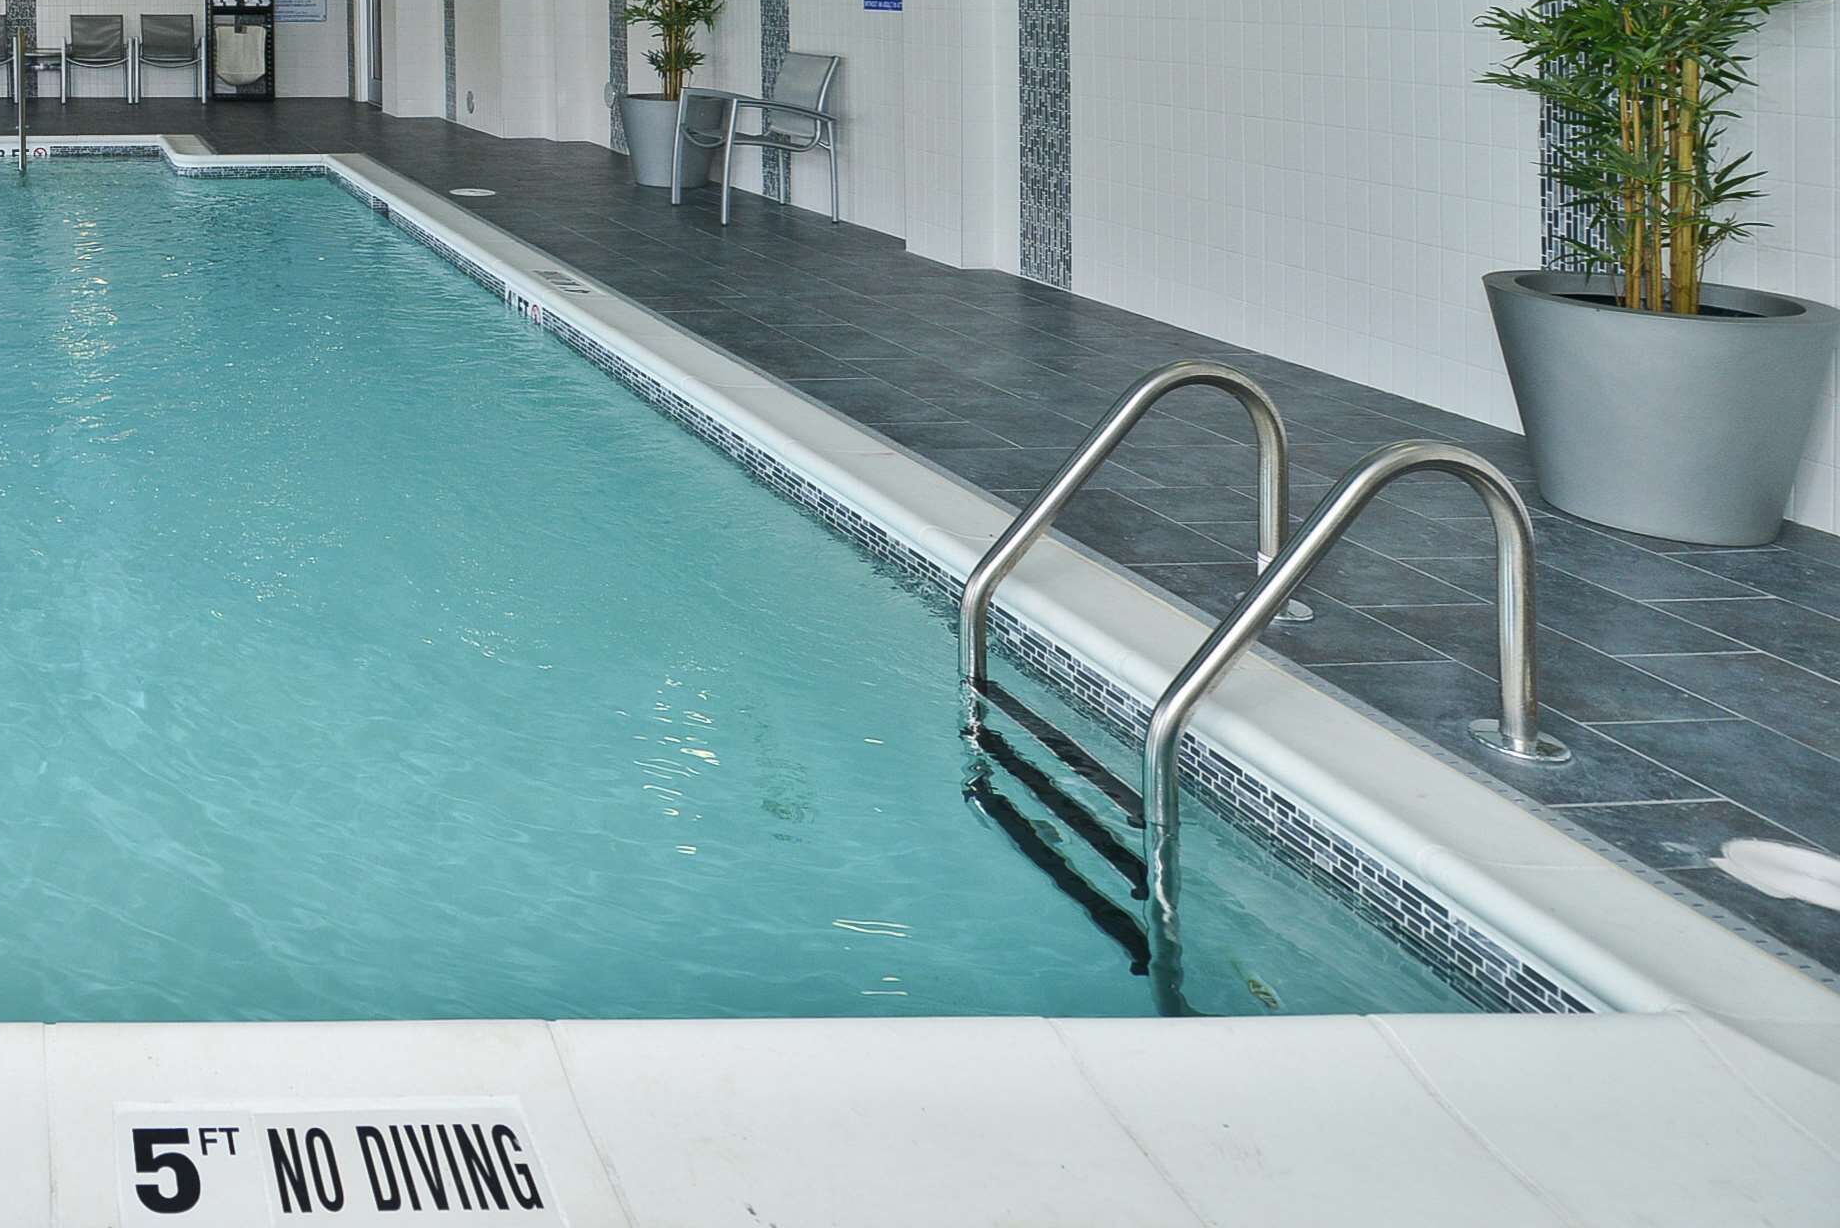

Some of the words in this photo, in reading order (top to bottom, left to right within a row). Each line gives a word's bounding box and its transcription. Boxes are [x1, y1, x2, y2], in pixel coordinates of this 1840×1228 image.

[132, 1127, 201, 1214] 5
[198, 1127, 240, 1156] FT
[266, 1127, 345, 1214] NO
[355, 1123, 545, 1213] DIVING
